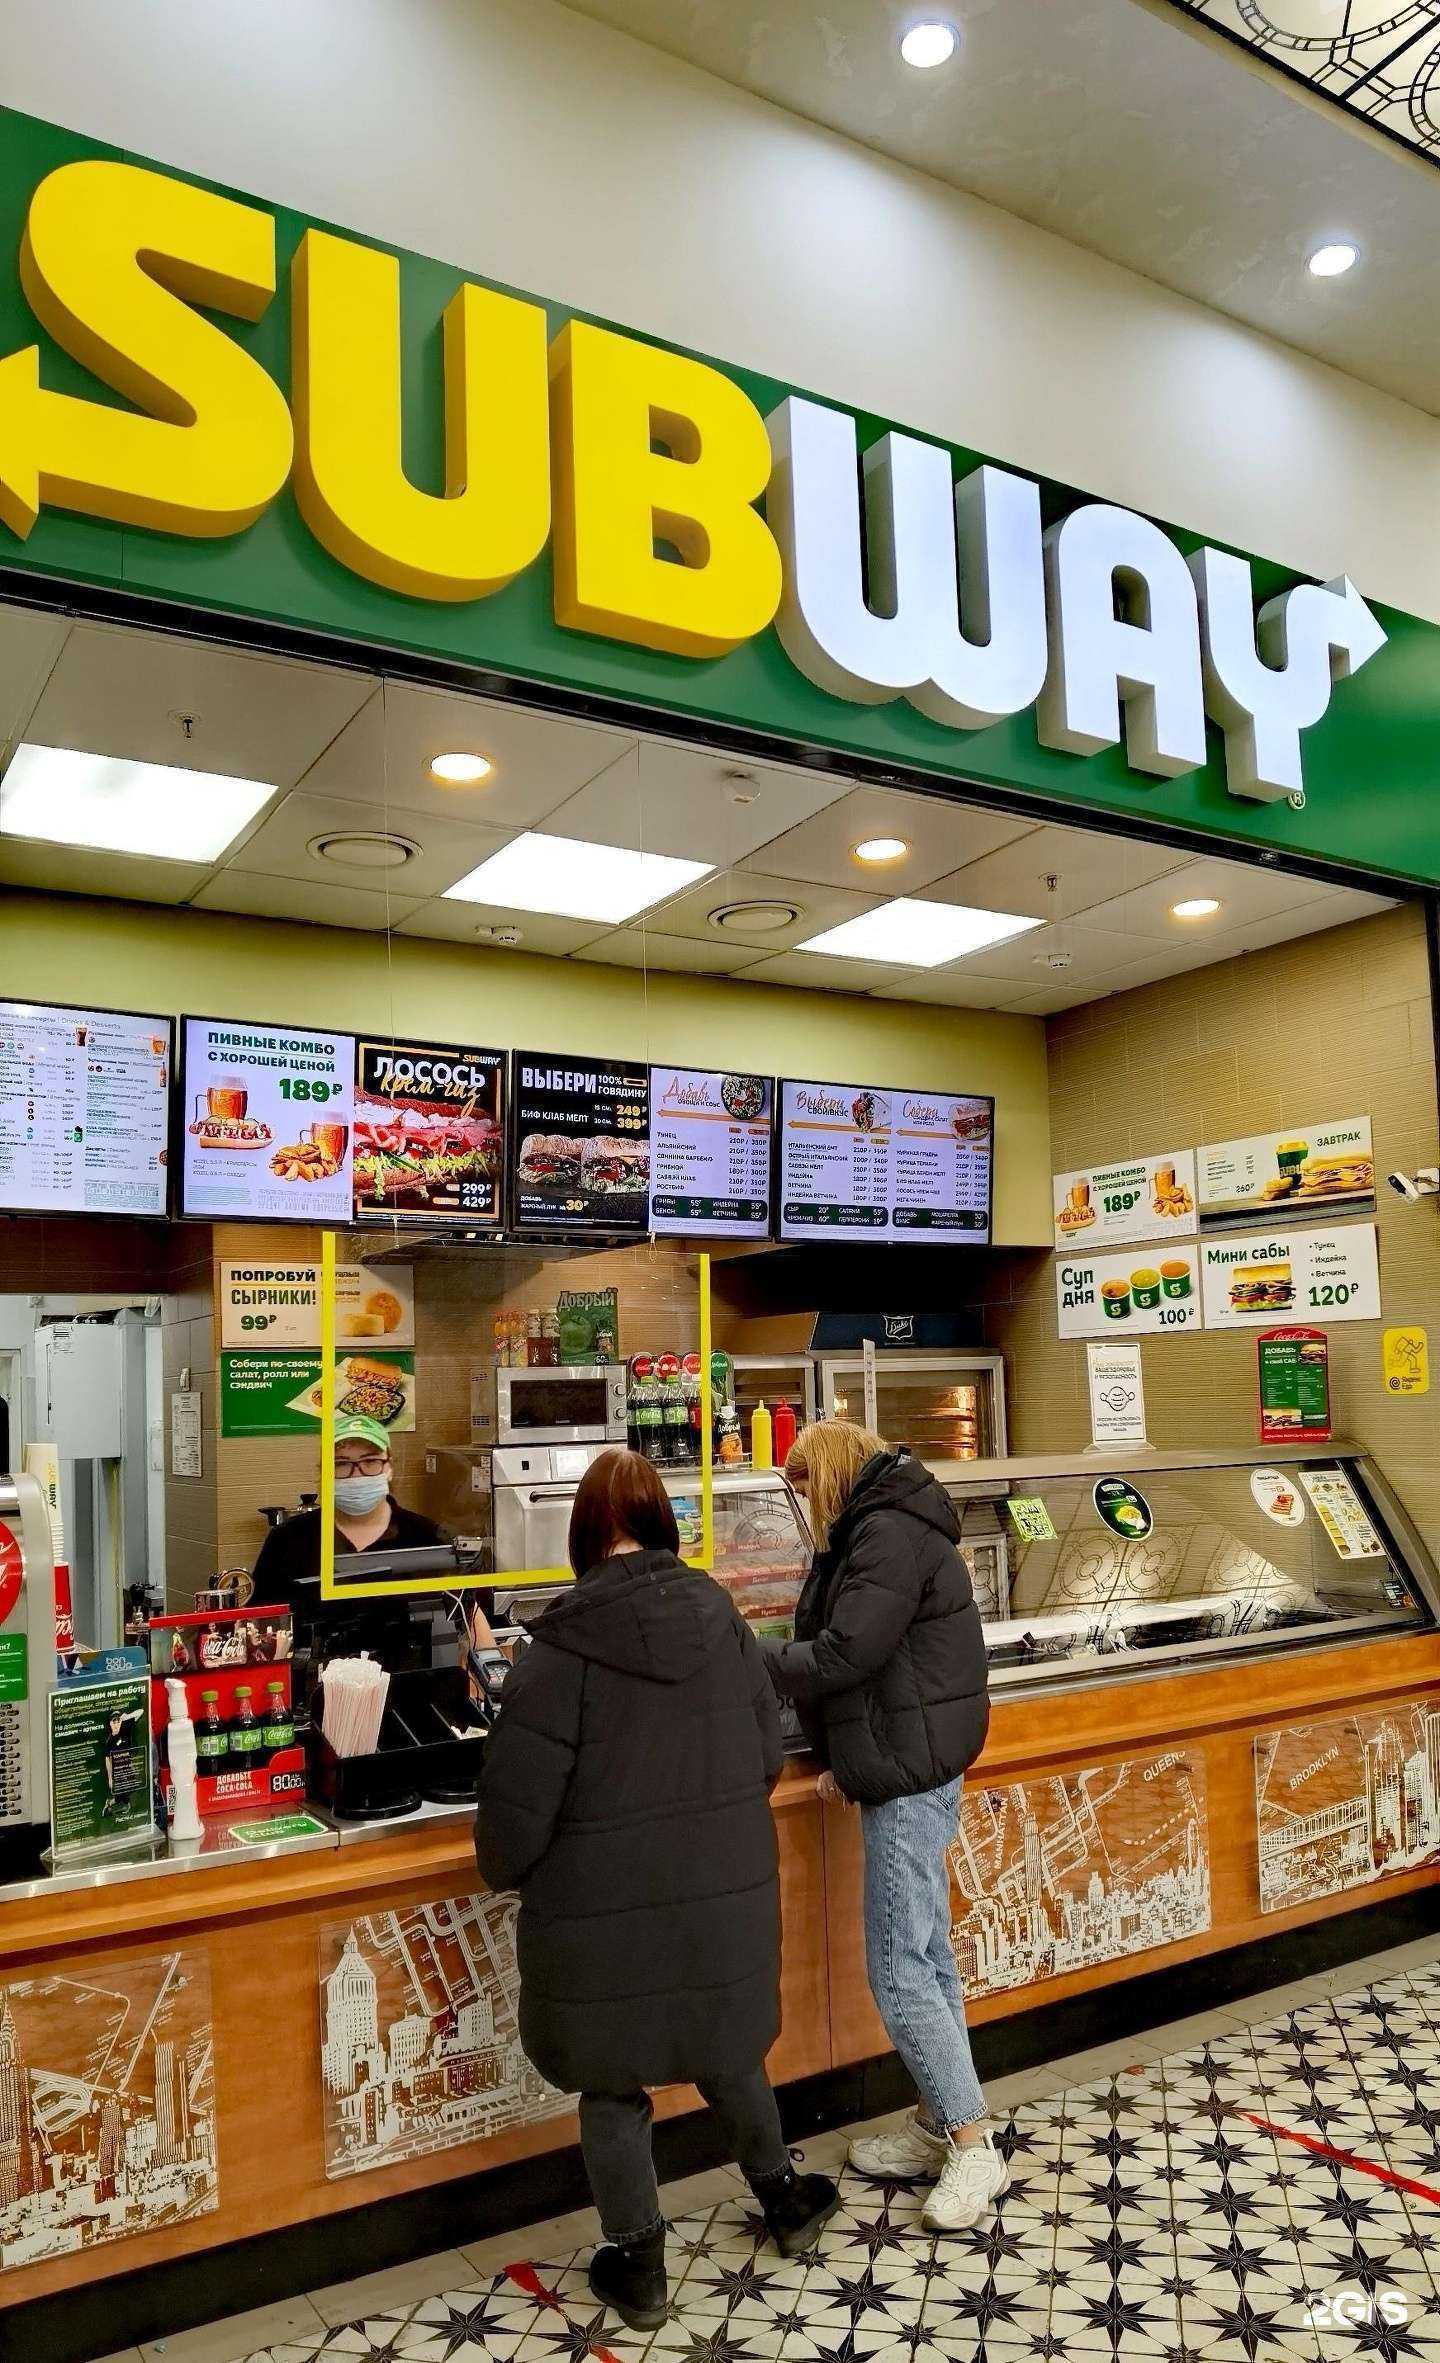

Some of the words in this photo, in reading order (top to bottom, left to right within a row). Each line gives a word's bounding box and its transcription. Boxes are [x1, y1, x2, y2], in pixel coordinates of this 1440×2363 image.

[0, 160, 1389, 805] SUBWAY
[208, 1031, 277, 1050] ПИВНЫЕ
[279, 1038, 335, 1056] КОМБО
[208, 1051, 218, 1062] С
[220, 1052, 287, 1068] ХОРОШЕЙ
[290, 1058, 335, 1073] ЦЕНОЙ
[462, 1054, 501, 1066] SUBWAY
[374, 1056, 486, 1088] ЛОСОСЬ
[522, 1067, 596, 1094] ВЫБЕРИ
[598, 1075, 623, 1086] 100%
[598, 1086, 647, 1098] ГОВЯДИНУ
[521, 1109, 540, 1119] БИФ
[543, 1111, 565, 1121] КЛАБ
[1316, 1131, 1361, 1147] ЗАВТРАК
[1092, 1171, 1120, 1182] ПИВНЫЕ
[1121, 1166, 1146, 1178] КОМБО
[1098, 1180, 1125, 1191] ХОРОШЕЙ
[1207, 1249, 1247, 1265] Мини
[1251, 1242, 1290, 1260] сабы
[231, 1269, 316, 1282] ПОПРОБУЙ
[1061, 1267, 1094, 1290] Суп
[1316, 1268, 1347, 1278] Ветчина
[231, 1289, 317, 1306] СЫРНИКИ!
[559, 1288, 616, 1311] Добрый
[1062, 1290, 1095, 1308] дня
[230, 1359, 268, 1369] Собери
[271, 1359, 323, 1370] по-своему
[230, 1371, 261, 1380] салат,
[263, 1371, 289, 1380] ролл
[290, 1371, 310, 1379] или
[229, 1382, 273, 1391] сэндвич
[54, 1691, 106, 1708] Приглашаем
[107, 1689, 117, 1698] на
[118, 1684, 146, 1697] работу
[1143, 1750, 1186, 1783] QUEENS
[1290, 1745, 1340, 1790] BROOKLYN
[217, 1770, 252, 1785] ДОБАВЬТЕ
[217, 1780, 253, 1794] COCA-COLA
[994, 1797, 1009, 1869] MANHATTAN
